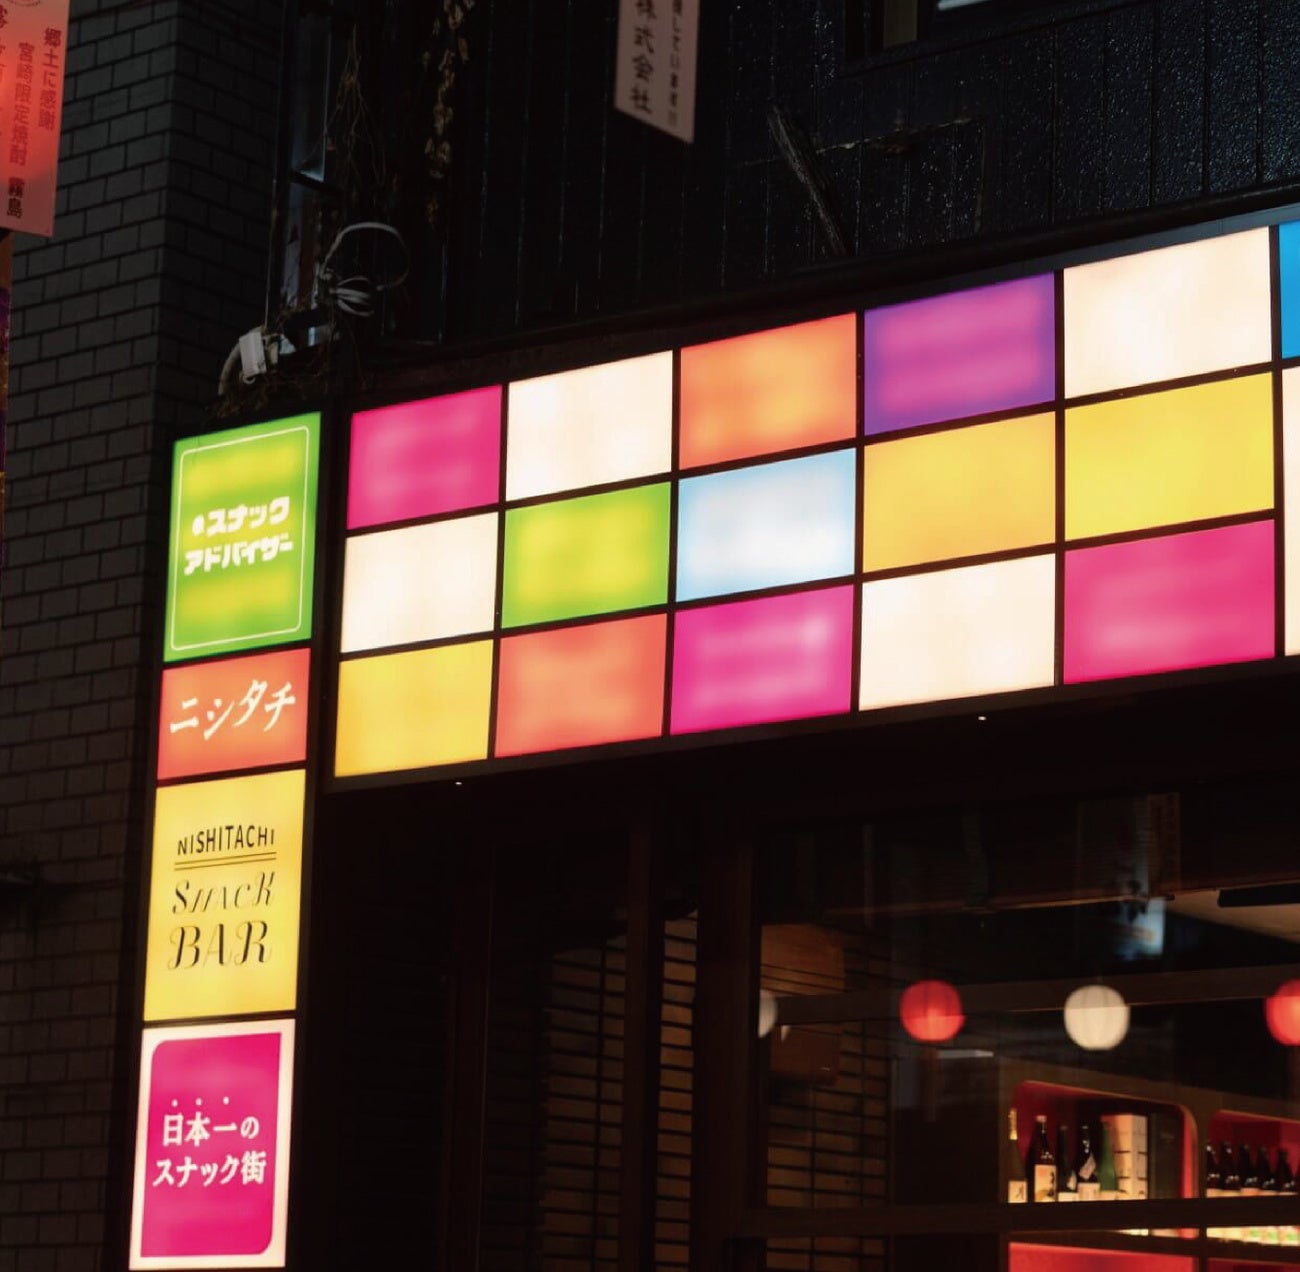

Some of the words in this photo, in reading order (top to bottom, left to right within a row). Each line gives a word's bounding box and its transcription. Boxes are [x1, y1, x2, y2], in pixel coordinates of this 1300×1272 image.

[207, 496, 290, 537] スナック
[184, 533, 294, 576] アドバイザー
[170, 679, 296, 740] ニシタチ
[177, 824, 275, 856] NISHITACHI
[167, 920, 273, 971] BAR
[162, 1111, 260, 1147] 日本一の
[152, 1150, 267, 1188] スナック街
